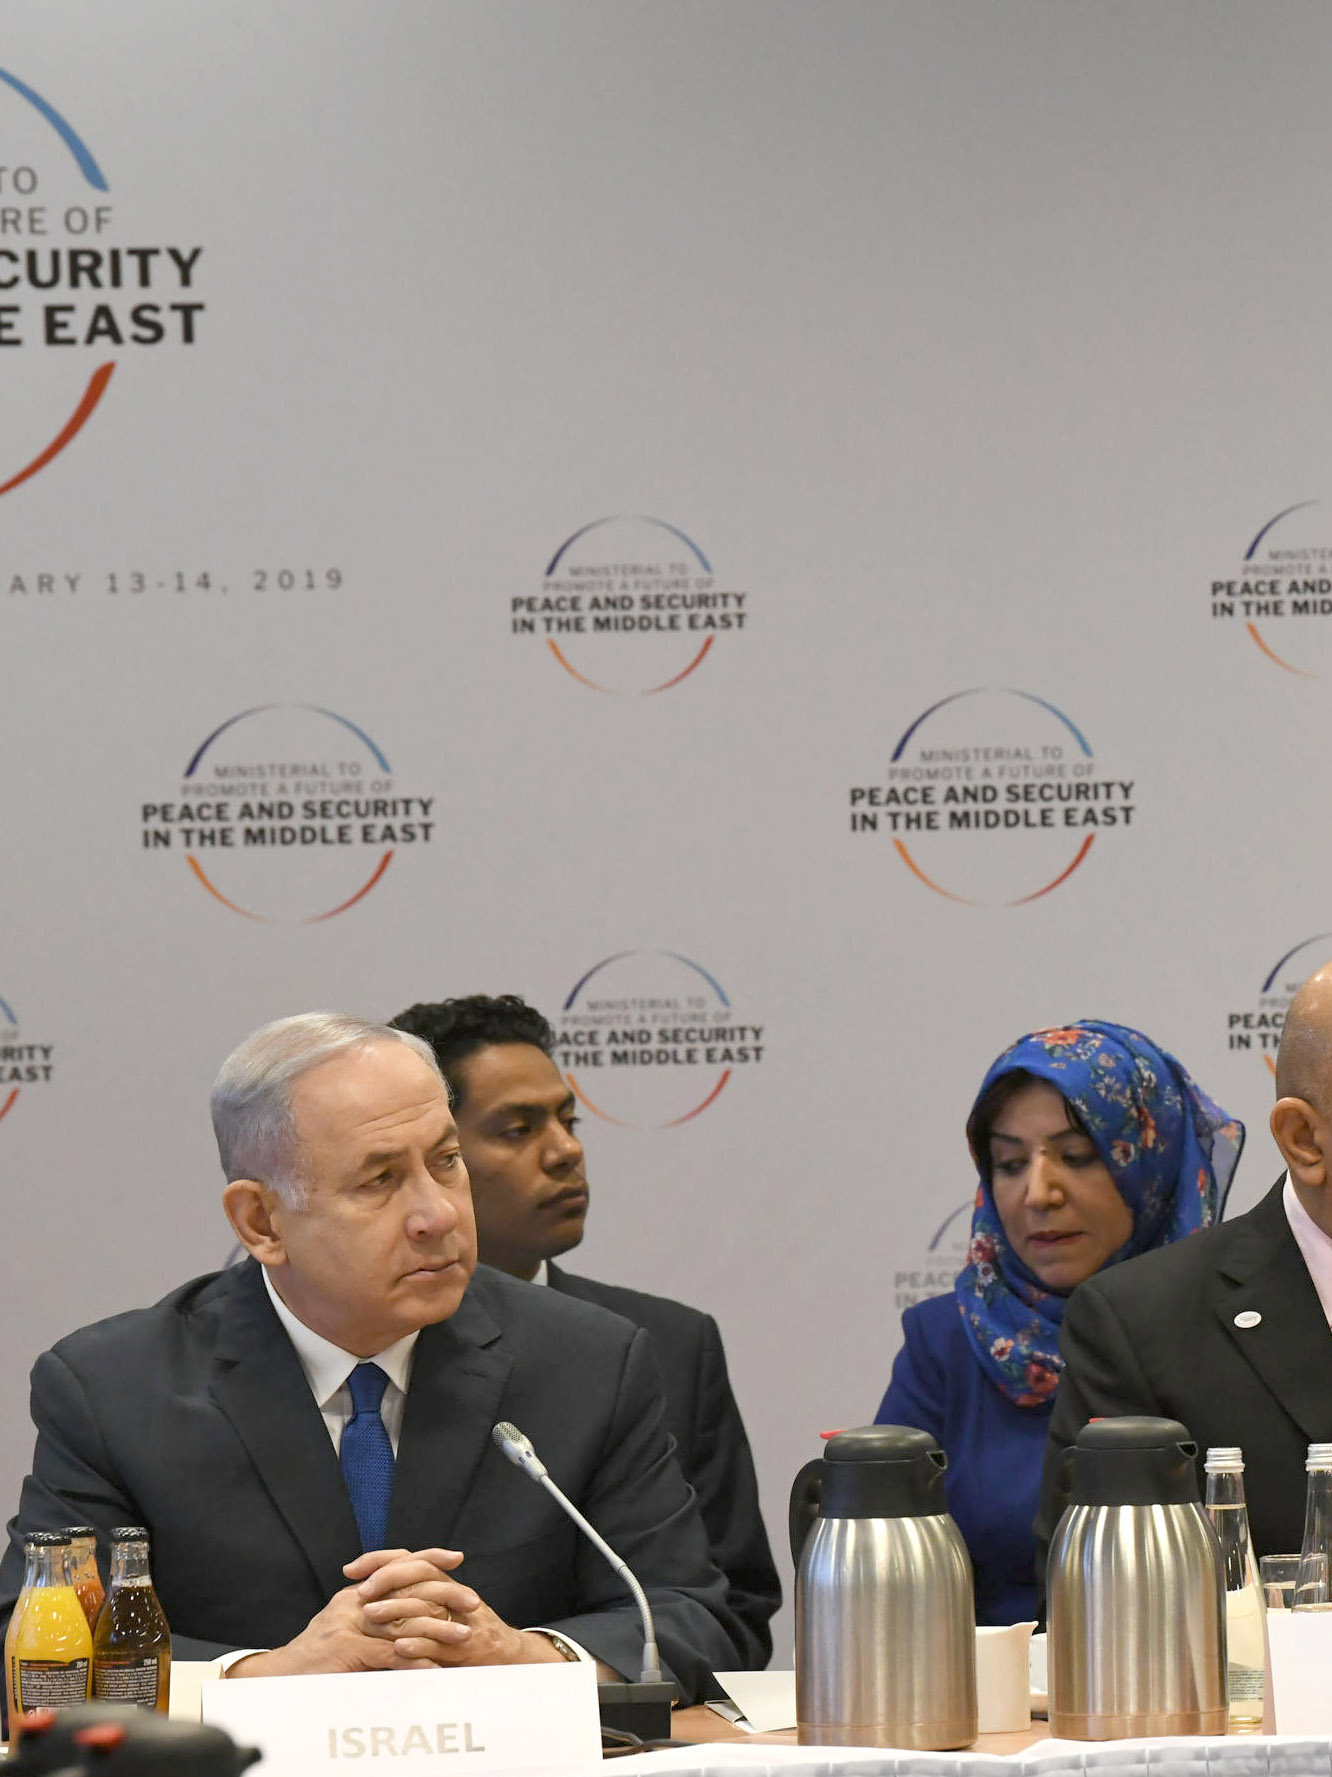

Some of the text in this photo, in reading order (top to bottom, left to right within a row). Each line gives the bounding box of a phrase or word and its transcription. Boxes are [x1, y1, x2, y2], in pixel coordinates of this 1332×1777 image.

[63, 206, 113, 236] OF
[0, 247, 204, 290] CURITY
[44, 303, 206, 346] EAST
[106, 571, 229, 596] 13-14,
[252, 567, 344, 592] 2019
[1212, 580, 1281, 596] PEACE
[1287, 579, 1331, 595] AND
[512, 592, 746, 612] PEACE AND SECURITY
[1213, 601, 1234, 617] IN
[1241, 600, 1284, 616] THE
[513, 613, 748, 633] IN THE MIDDLE EAST
[920, 746, 1062, 762] MINISTERIAL TO
[214, 762, 360, 778] MINISTERIAL TO
[889, 763, 1095, 781] PROMOTE A FUTURE OF
[182, 779, 394, 797] PROMOTE A FUTURE OF
[851, 781, 1135, 806] PEACE AND SECURITY
[143, 797, 434, 823] PEACE AND SECURITY
[852, 806, 1136, 832] IN THE MIDDLE EAST
[144, 822, 435, 848] IN THE MIDDLE EAST
[1228, 1013, 1284, 1029] PEAC
[560, 1025, 764, 1047] ACE AND SECURITY
[1229, 1033, 1281, 1050] IN TH
[560, 1046, 765, 1067] THE MIDDLE EAST
[894, 1271, 956, 1288] PEAC
[328, 1722, 485, 1759] ISRAEL
